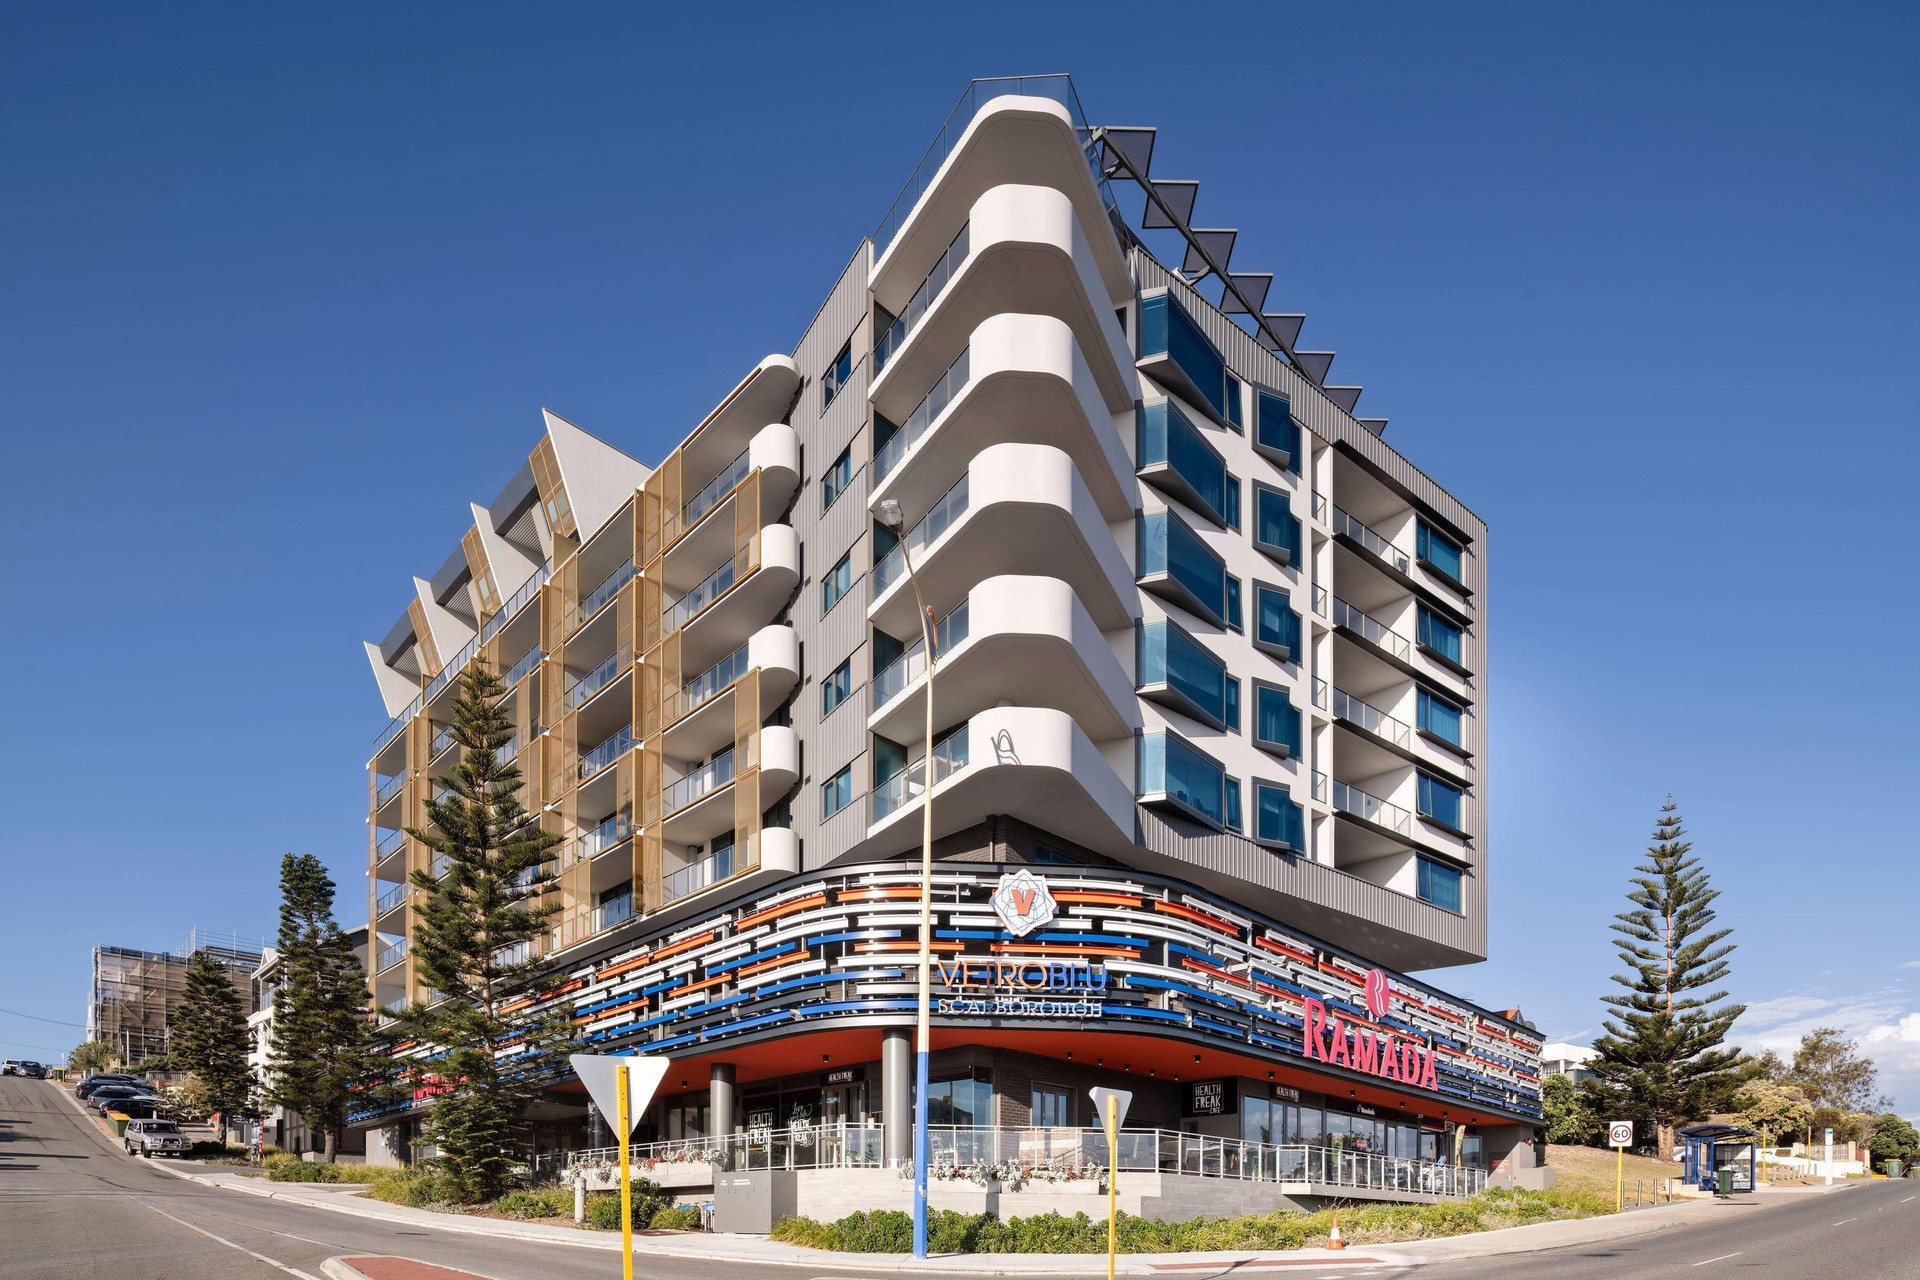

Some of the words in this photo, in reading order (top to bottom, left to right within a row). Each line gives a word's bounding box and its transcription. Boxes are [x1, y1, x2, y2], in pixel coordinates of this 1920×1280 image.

[1011, 889, 1036, 916] V
[937, 959, 1107, 991] VETROBLU
[938, 998, 1102, 1018] SCARBOROUGH
[1303, 997, 1438, 1091] RAMADA
[1195, 1084, 1221, 1096] HEALTH
[1195, 1095, 1221, 1109] FREAK
[749, 1112, 772, 1128] HEALTH
[1613, 1129, 1629, 1139] 60
